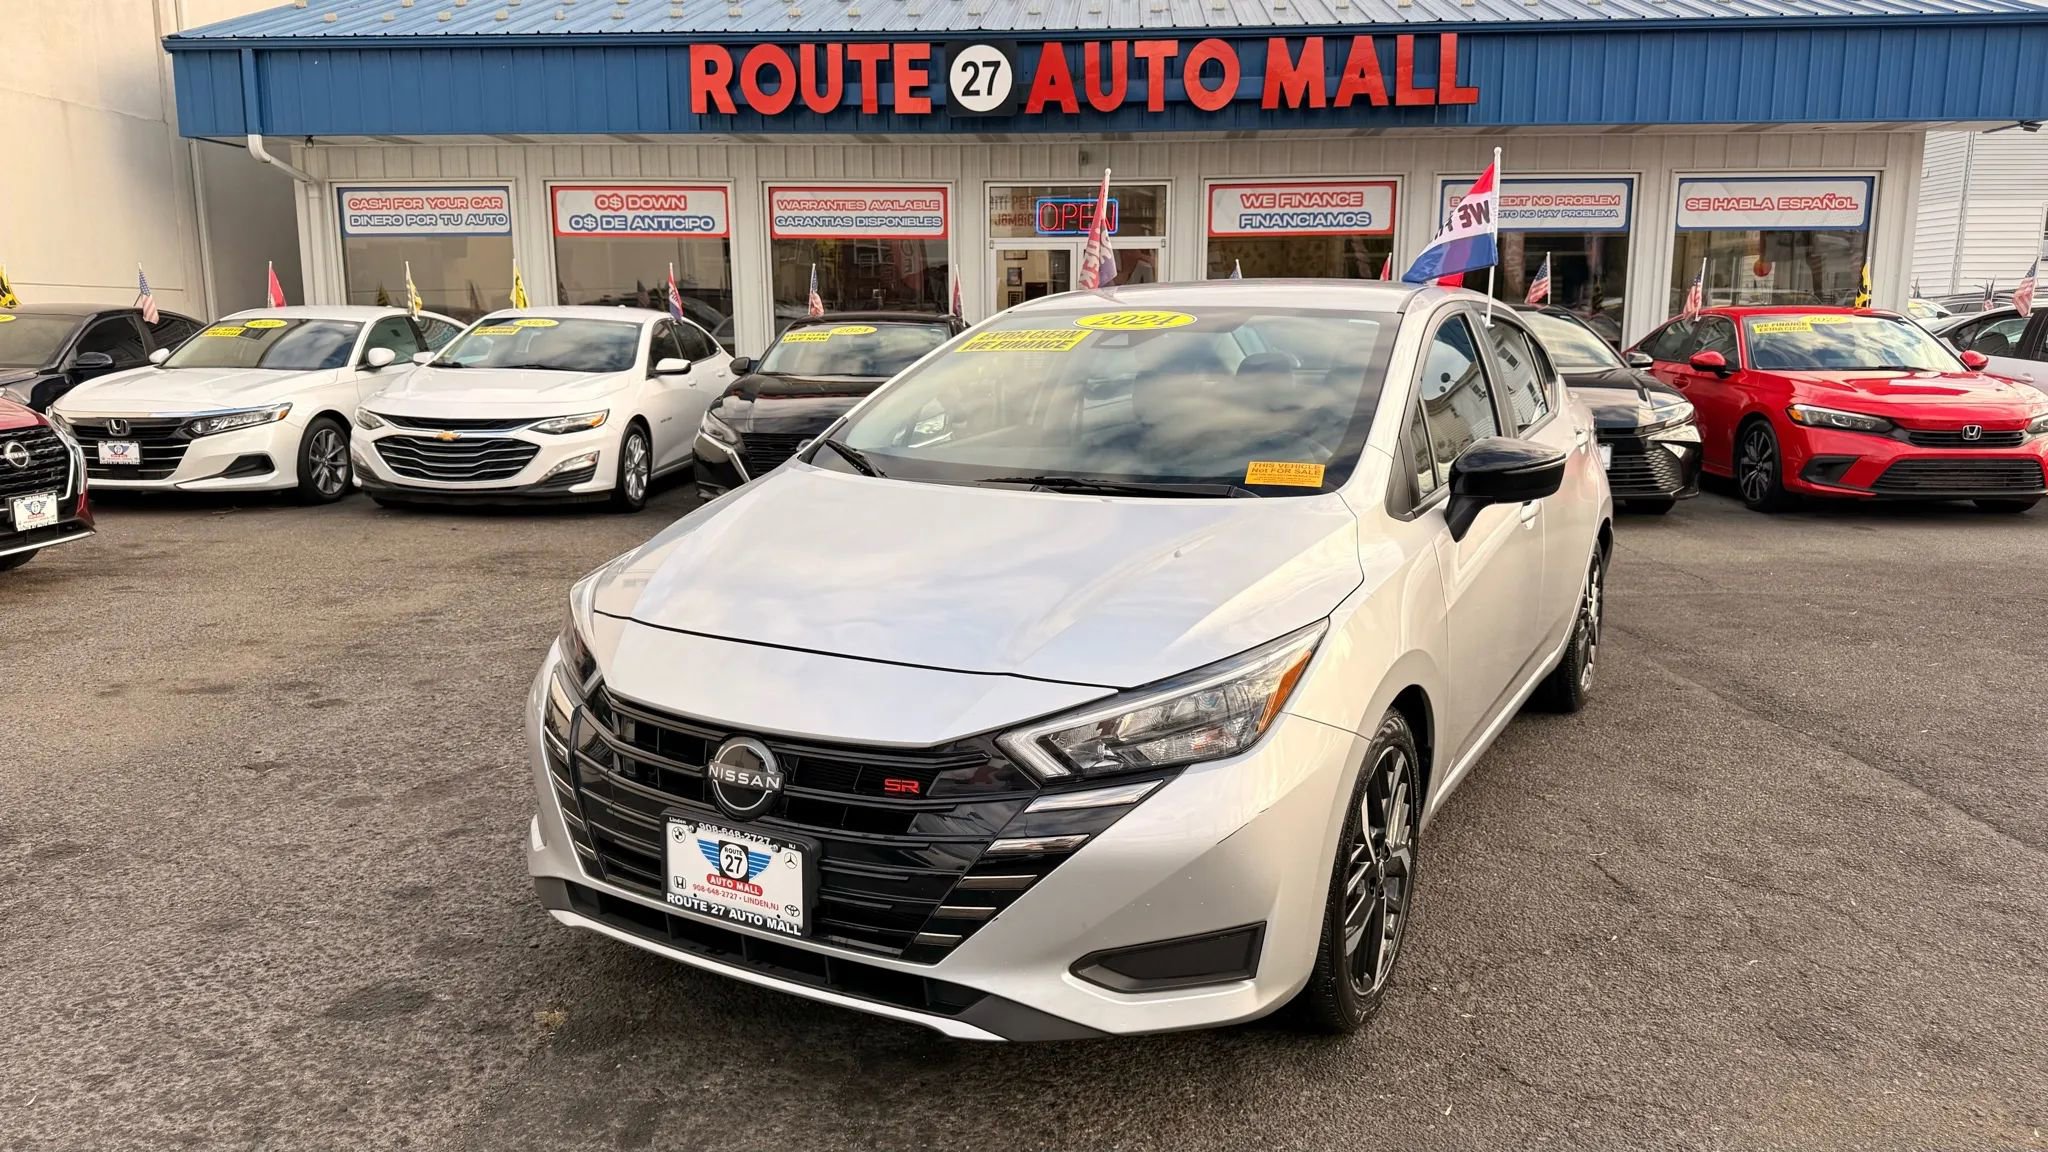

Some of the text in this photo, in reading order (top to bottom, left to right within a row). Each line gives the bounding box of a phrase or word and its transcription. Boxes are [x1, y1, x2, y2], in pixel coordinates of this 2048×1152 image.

[689, 32, 1479, 115] ROUTE 27 AUTO MALL
[349, 197, 503, 209] CASH FOR YOUR CAR
[627, 195, 687, 211] DOWN
[777, 199, 940, 211] WARRANTIES AVAILABLE
[1240, 191, 1363, 208] WE FINANCE
[1499, 195, 1620, 206] EDIT NO PROBLEM
[1686, 193, 1857, 211] SE HABLA ESPAÑOL
[350, 213, 508, 227] DINERO POR TU AUTO
[775, 216, 943, 227] GARANTIAS DISPONIBLES
[1040, 203, 1116, 231] OPEN
[1240, 212, 1371, 229] FINANCIAMOS
[1520, 209, 1536, 219] NO
[1537, 209, 1562, 218] HAY
[1562, 209, 1618, 218] PROBLEMA
[601, 215, 627, 230] DE
[630, 215, 715, 231] ANTICIPO
[1093, 314, 1181, 326] 2024
[979, 330, 1084, 340] EXTRA CLEAN
[963, 340, 1075, 350] WE FINANCE
[708, 764, 780, 789] NISSAN
[884, 778, 919, 793] SR
[698, 823, 770, 845] 908-648-2727
[724, 847, 743, 857] ROUTE
[725, 855, 743, 874] 27
[693, 884, 738, 901] 908-648-2727
[710, 875, 761, 895] AUTO MALL
[667, 893, 801, 936] ROUTE 27 AUTO MALL
